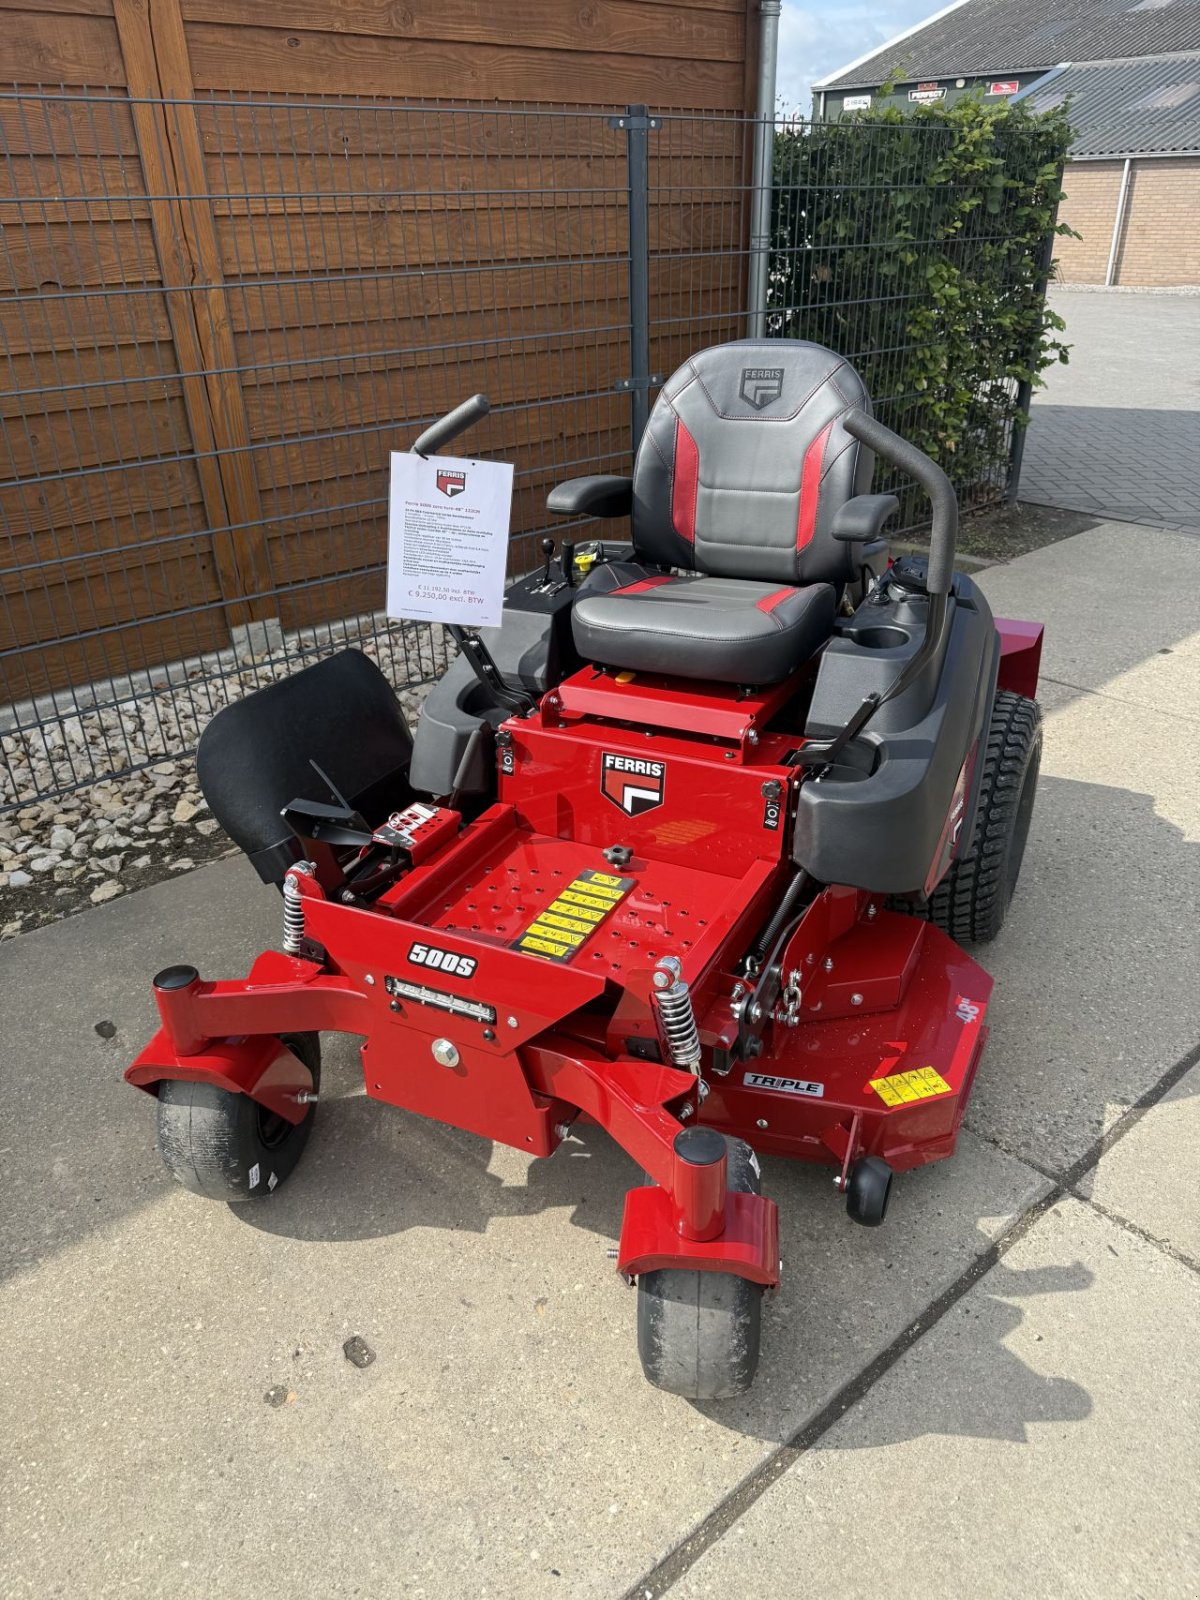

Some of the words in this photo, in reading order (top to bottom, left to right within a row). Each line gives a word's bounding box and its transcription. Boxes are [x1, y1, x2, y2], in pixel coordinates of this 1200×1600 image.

[911, 90, 943, 100] PERFECT
[745, 370, 781, 379] FERRIS
[438, 470, 465, 479] FERRIS
[449, 594, 466, 602] excl.
[468, 596, 484, 605] BTW
[605, 755, 662, 777] FERRIS
[409, 944, 476, 977] 500S
